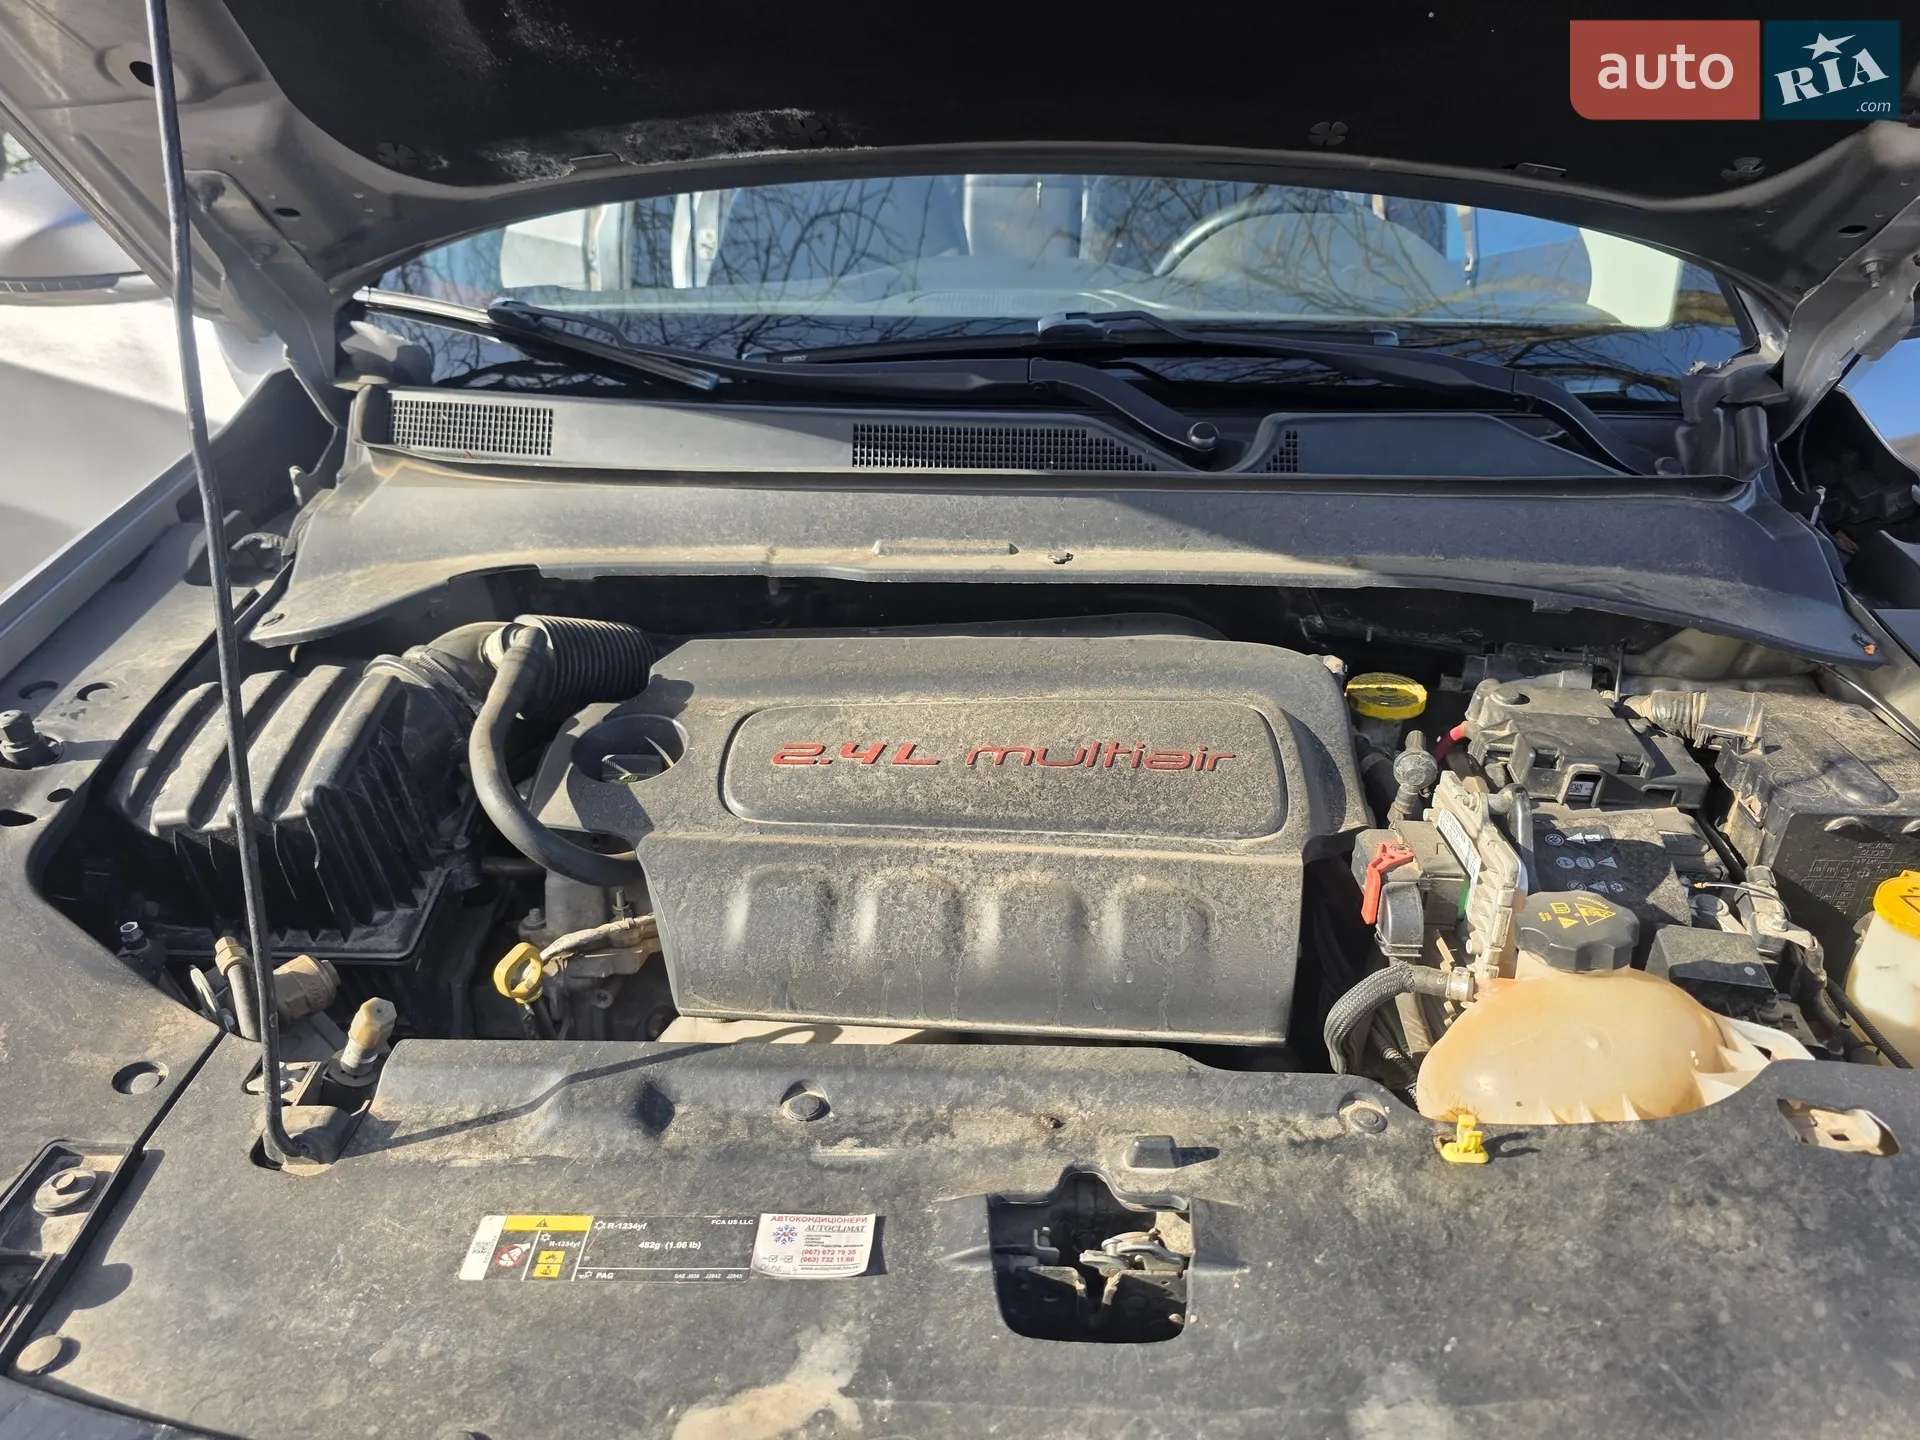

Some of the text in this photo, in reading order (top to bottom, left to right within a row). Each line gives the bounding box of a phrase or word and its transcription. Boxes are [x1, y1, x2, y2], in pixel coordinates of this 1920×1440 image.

[770, 741, 1237, 772] 2.4L multiair
[770, 1215, 868, 1224] АВТОКОНДИЦІОНЕРИ
[607, 1222, 648, 1230] R-1234yf
[804, 1224, 867, 1233] AUTOCLIMAT
[549, 1240, 581, 1248] R-1234yf
[638, 1241, 702, 1250] 482g (1.06 lb)
